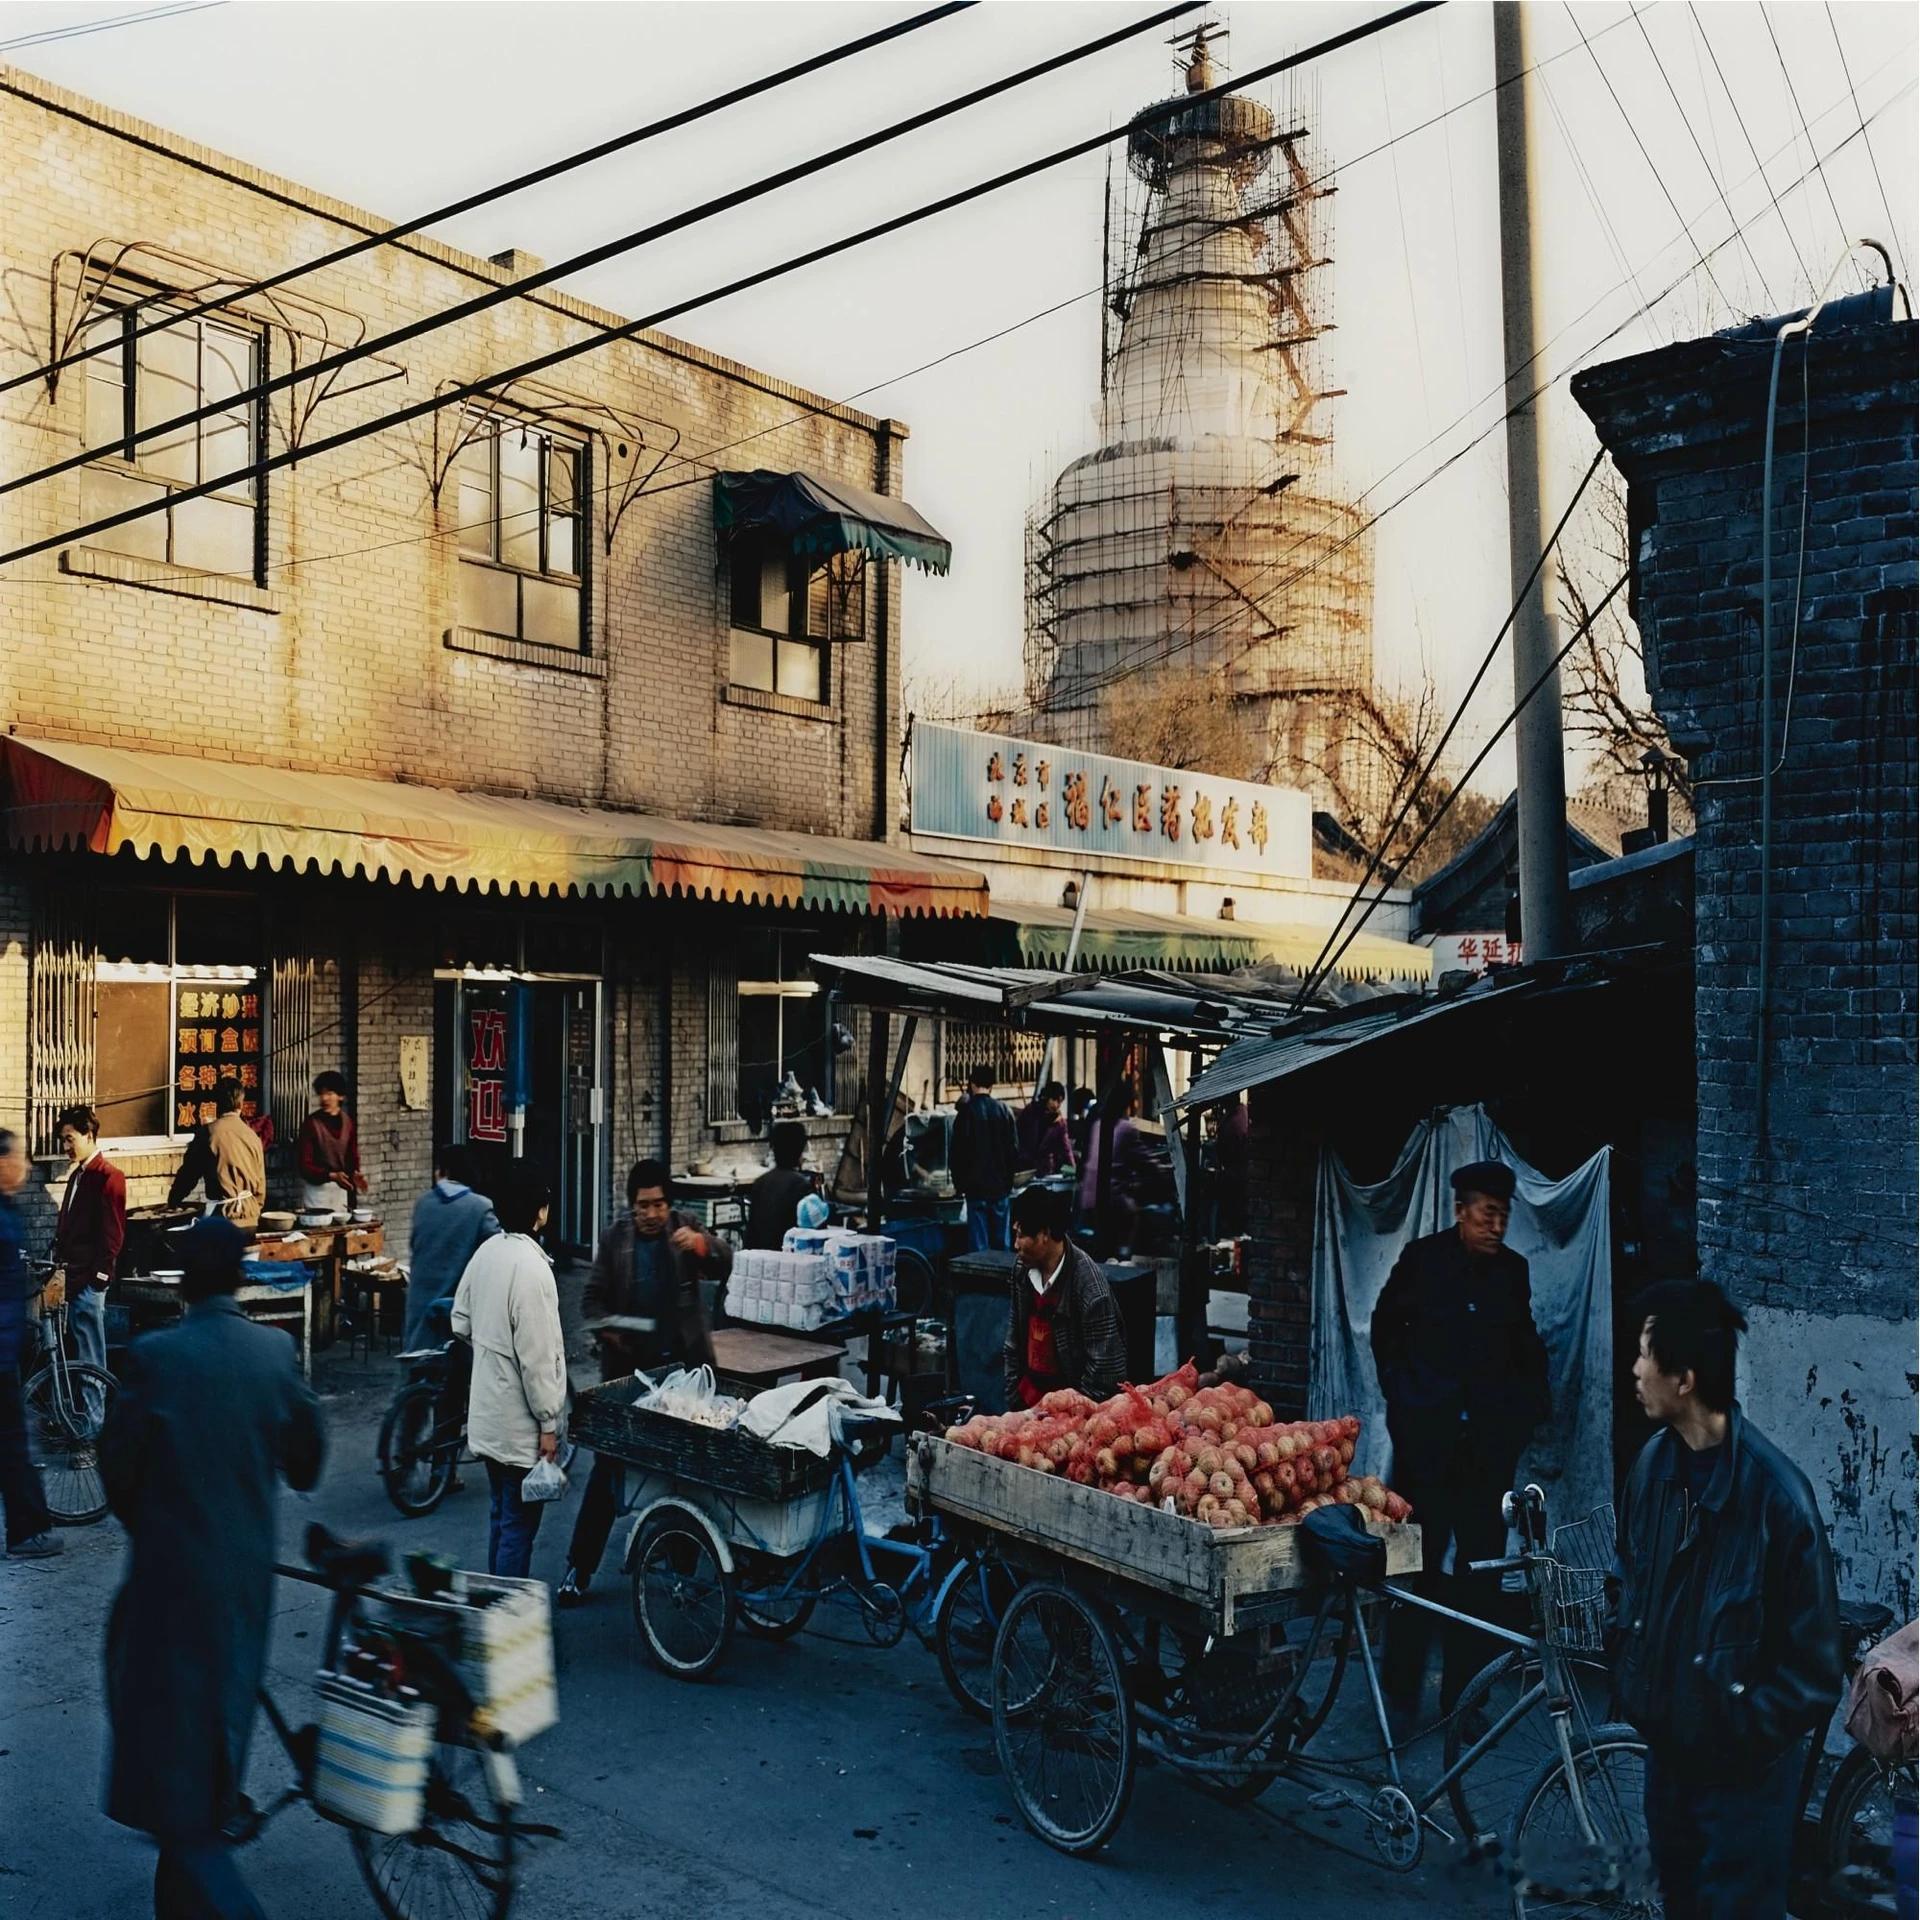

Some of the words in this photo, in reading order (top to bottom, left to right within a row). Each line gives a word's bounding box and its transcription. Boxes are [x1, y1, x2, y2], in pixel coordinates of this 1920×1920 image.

[179, 1027, 257, 1053] 预订盒饭
[469, 1009, 509, 1142] 欢迎
